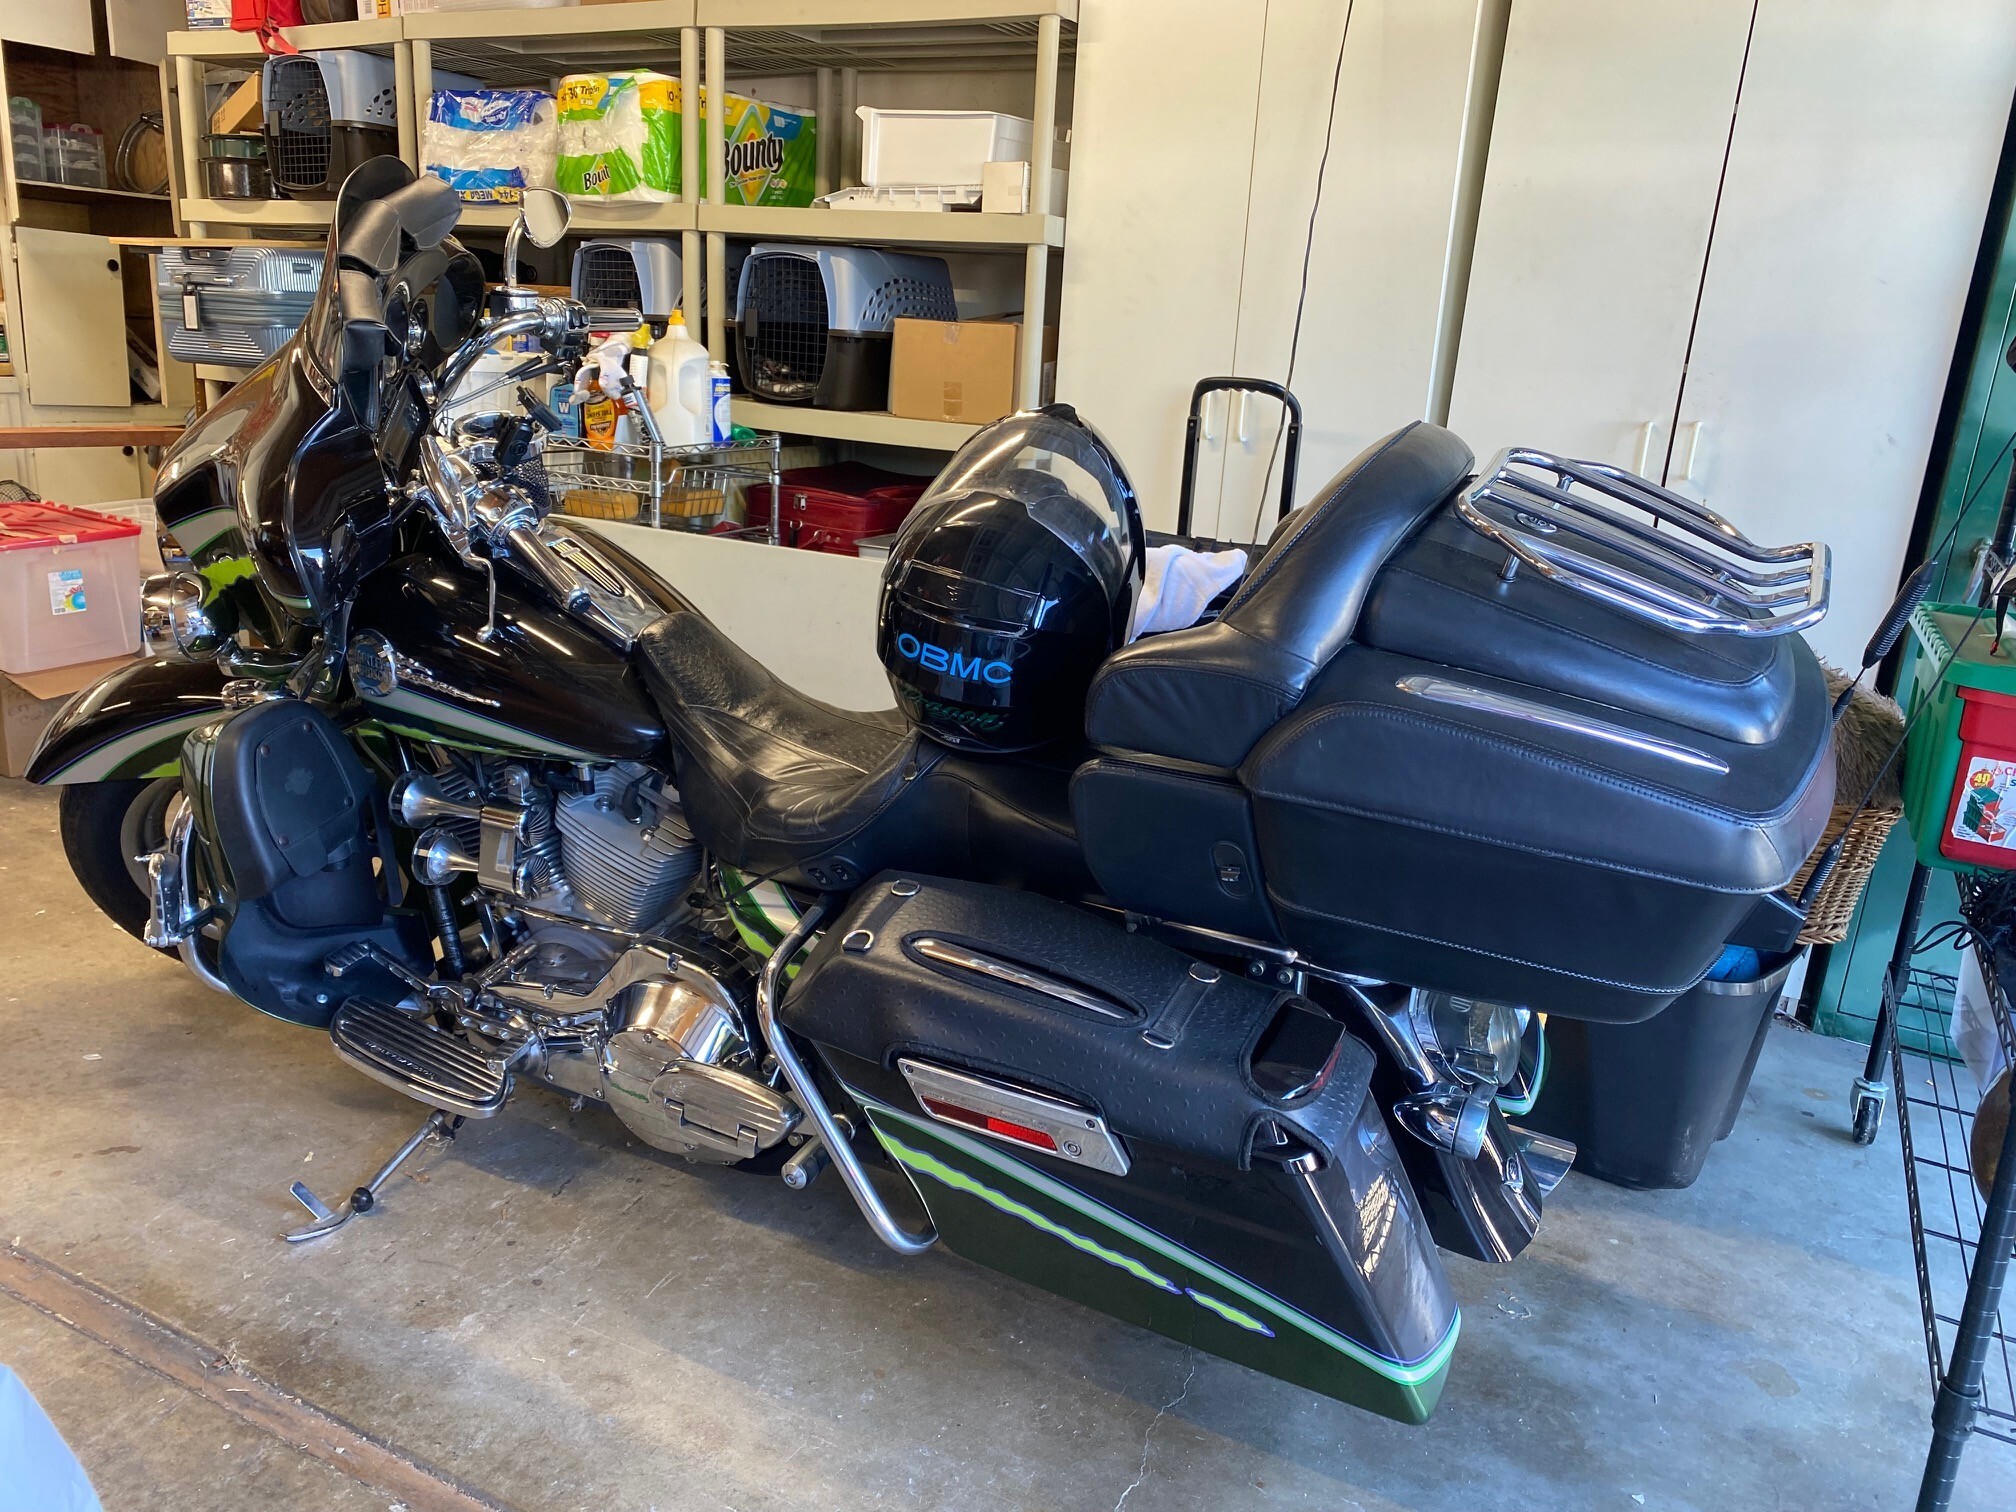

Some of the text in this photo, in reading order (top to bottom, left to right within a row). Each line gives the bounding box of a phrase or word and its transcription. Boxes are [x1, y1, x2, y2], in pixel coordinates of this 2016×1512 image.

[470, 190, 493, 200] MEGA
[558, 402, 570, 413] W
[898, 633, 1013, 684] OBMC
[1974, 773, 1991, 783] 40
